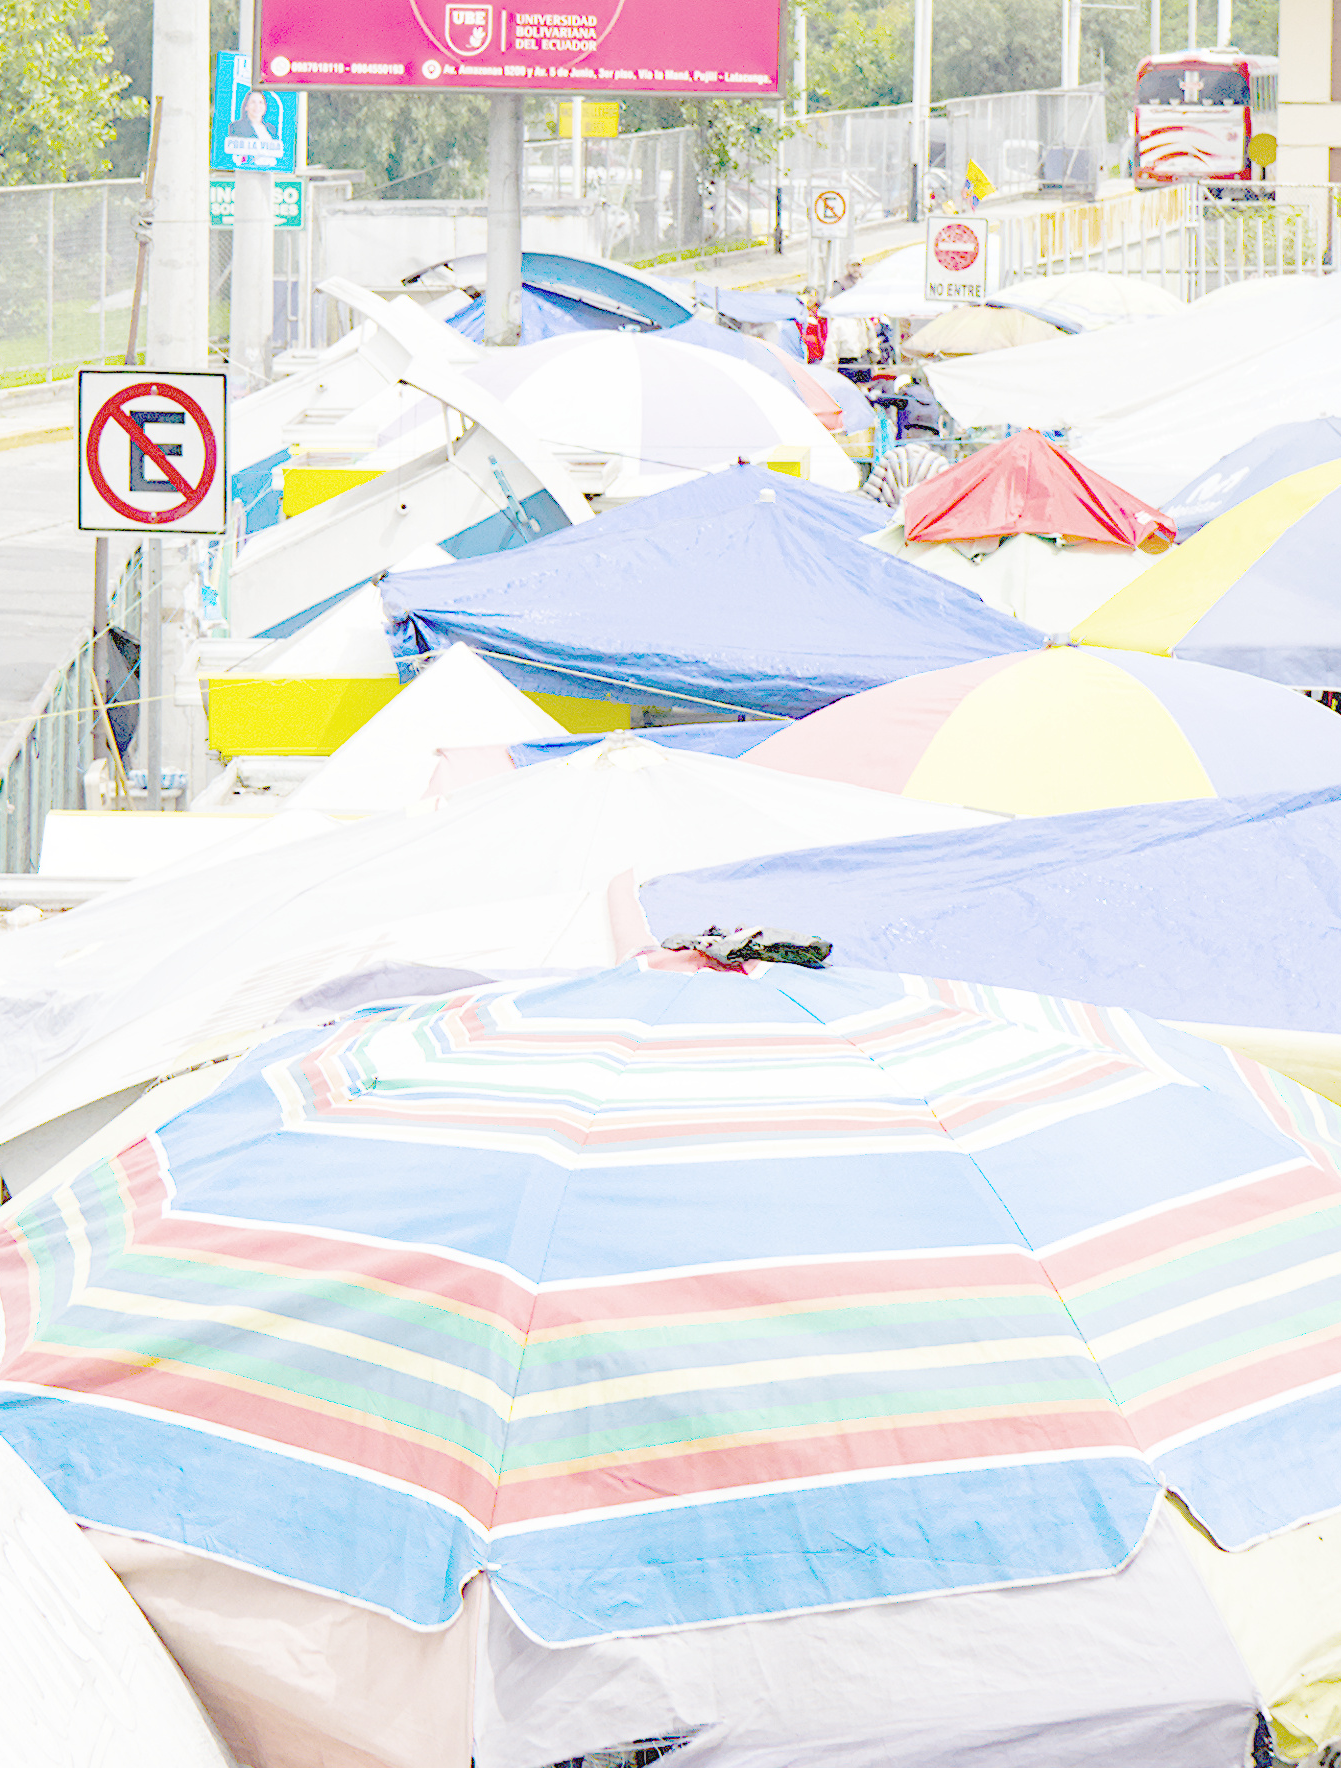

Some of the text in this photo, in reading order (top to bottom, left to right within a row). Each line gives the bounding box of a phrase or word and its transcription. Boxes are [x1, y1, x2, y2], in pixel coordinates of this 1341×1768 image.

[452, 10, 486, 25] UBE
[515, 13, 597, 27] UNIVERSIDAD
[515, 26, 597, 39] BOLIVARIANA
[515, 39, 597, 51] DEL ECUADOR
[929, 282, 981, 298] NO ENTRE
